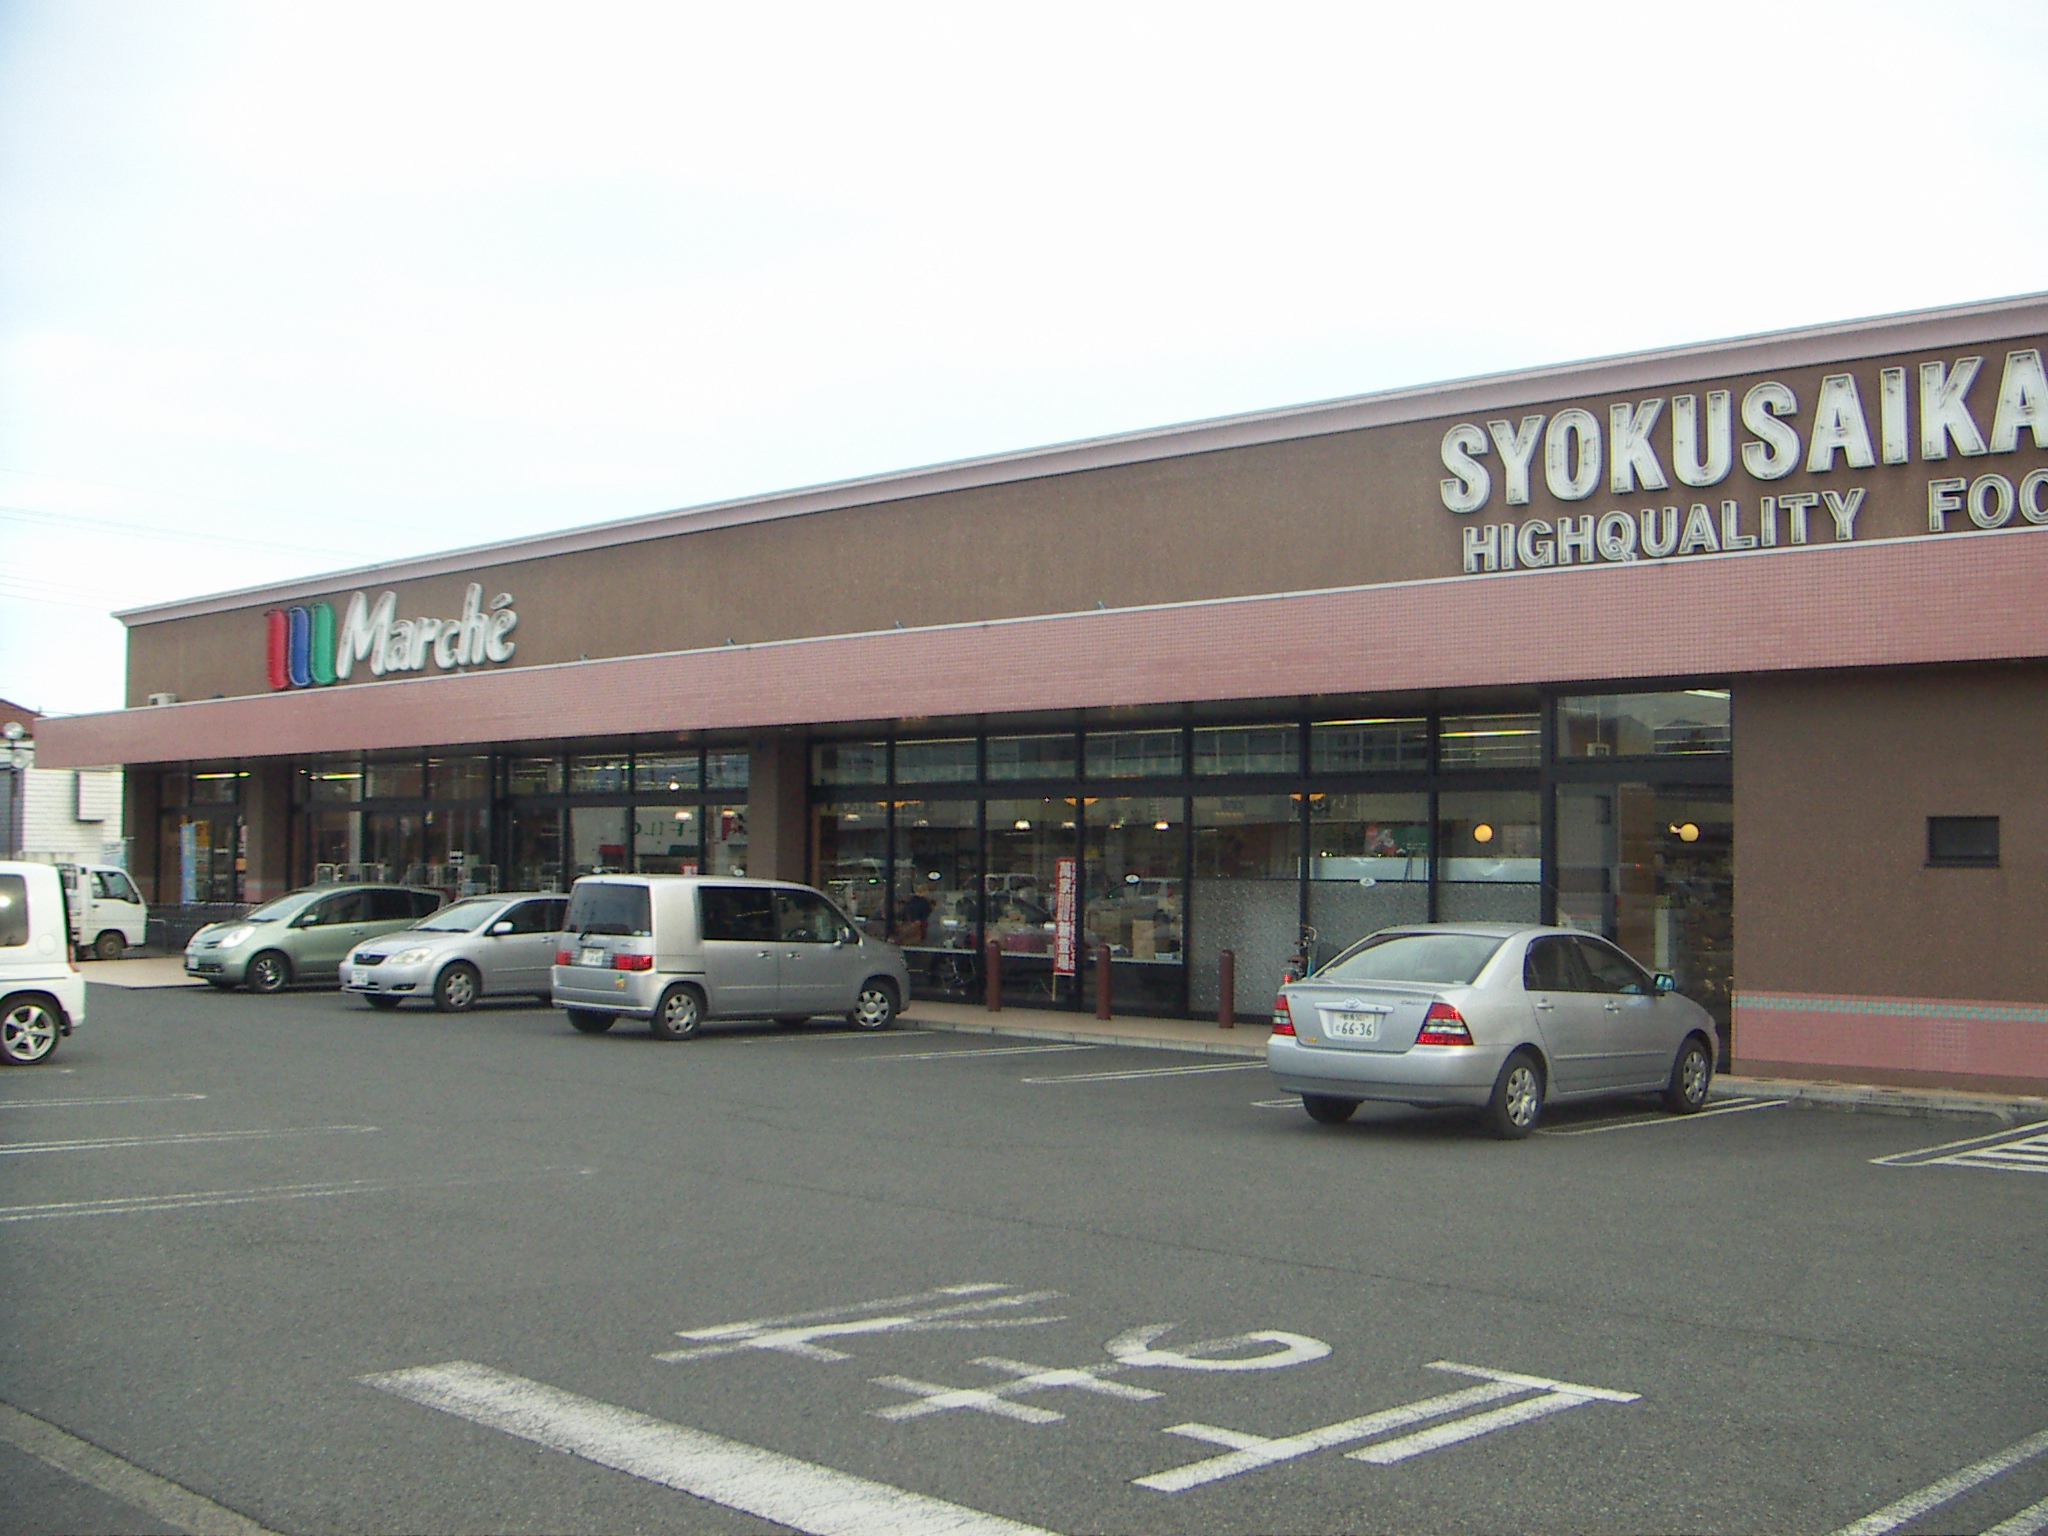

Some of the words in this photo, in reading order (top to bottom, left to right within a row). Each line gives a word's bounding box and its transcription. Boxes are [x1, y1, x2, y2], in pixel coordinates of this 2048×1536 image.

[1440, 348, 2048, 514] SYOKUSAIKA
[1463, 487, 1867, 573] HIGHQUALITY
[335, 582, 518, 680] Marché
